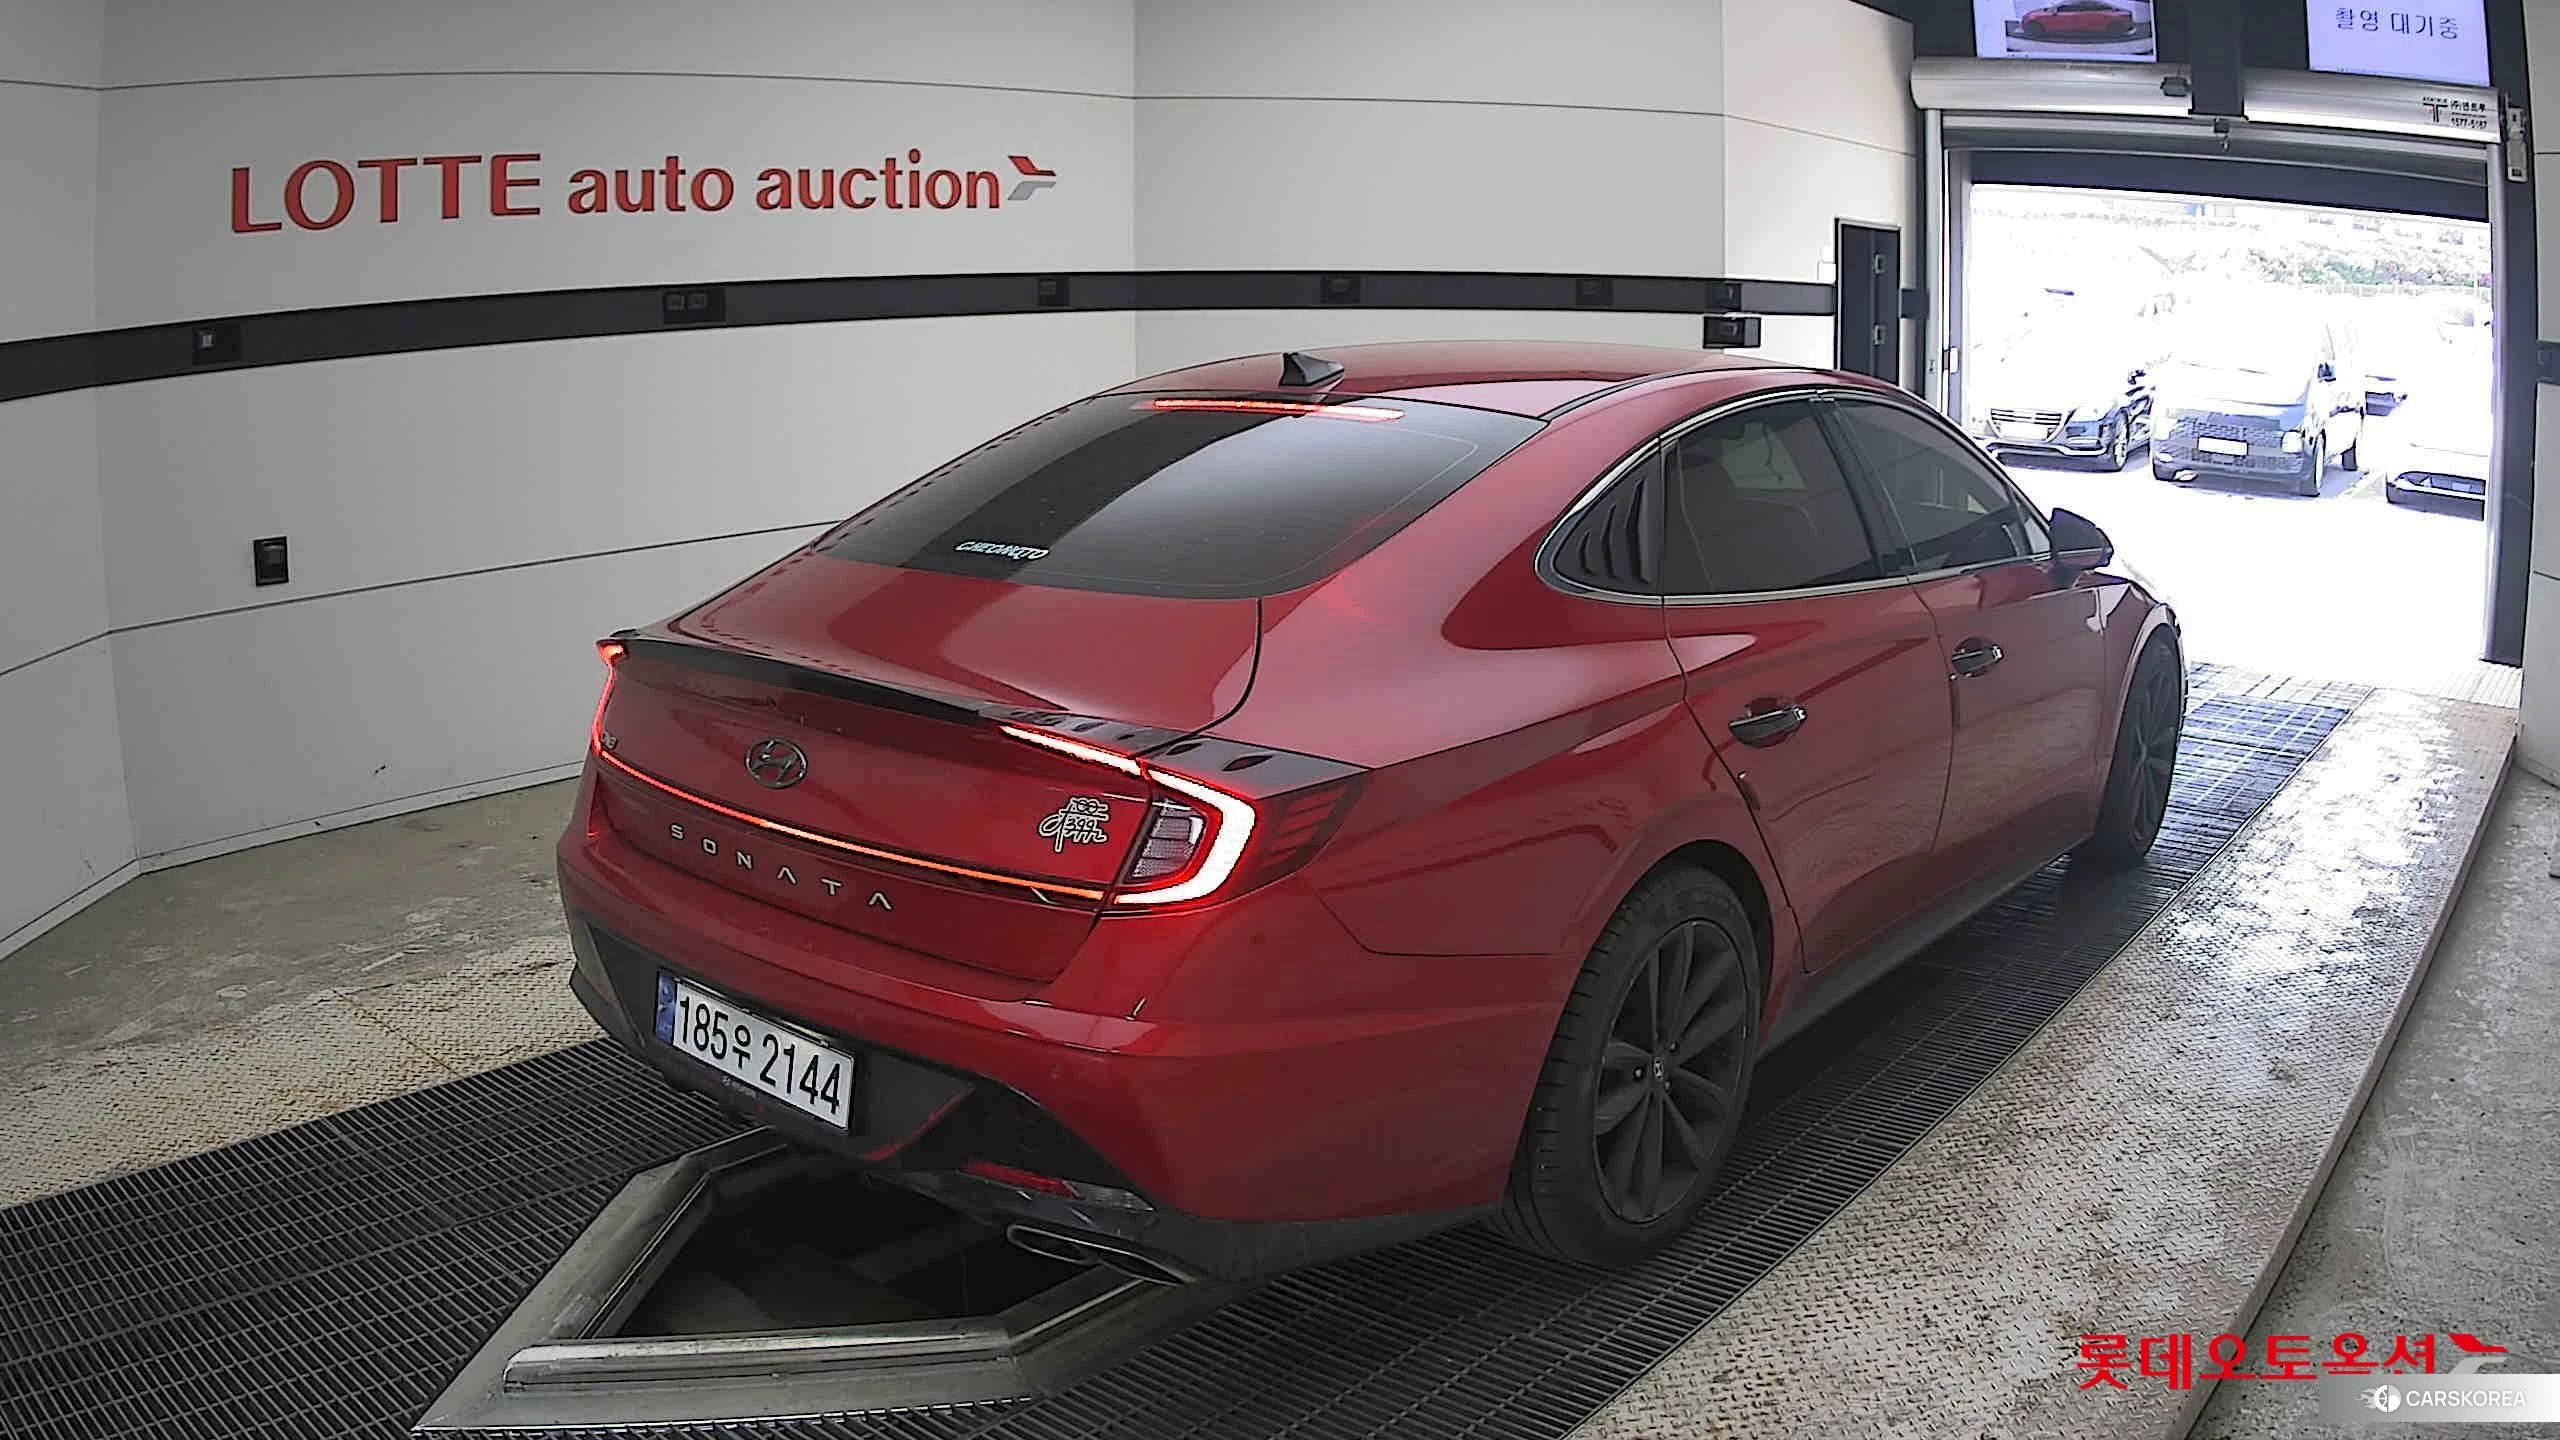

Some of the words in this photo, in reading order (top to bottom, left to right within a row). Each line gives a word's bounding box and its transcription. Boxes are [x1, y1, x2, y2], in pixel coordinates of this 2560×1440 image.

[2336, 8, 2379, 32] 촬영
[2391, 13, 2460, 40] 대기중
[231, 153, 541, 233] LOTTE
[568, 155, 733, 214] auto
[755, 149, 1000, 209] auction
[670, 824, 892, 911] SONATA
[679, 996, 751, 1069] 185우
[759, 1033, 840, 1114] 2144
